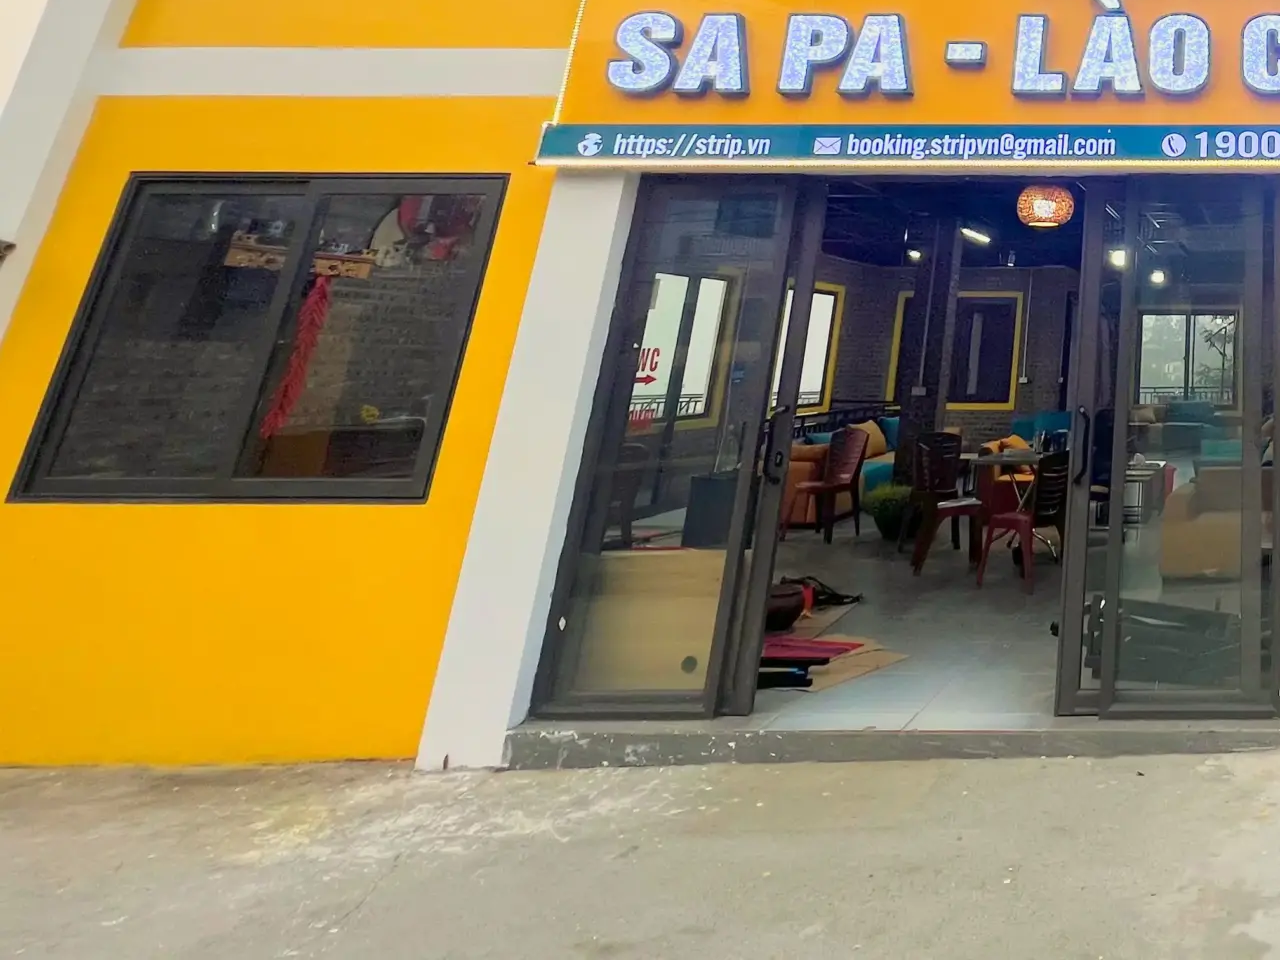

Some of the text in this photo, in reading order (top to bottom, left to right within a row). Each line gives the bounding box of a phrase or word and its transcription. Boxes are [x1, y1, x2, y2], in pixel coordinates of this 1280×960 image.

[606, 11, 750, 97] SA
[776, 12, 914, 97] PA
[613, 133, 771, 158] https://strip.vn
[847, 134, 1116, 160] booking.stripvn@gmail.com
